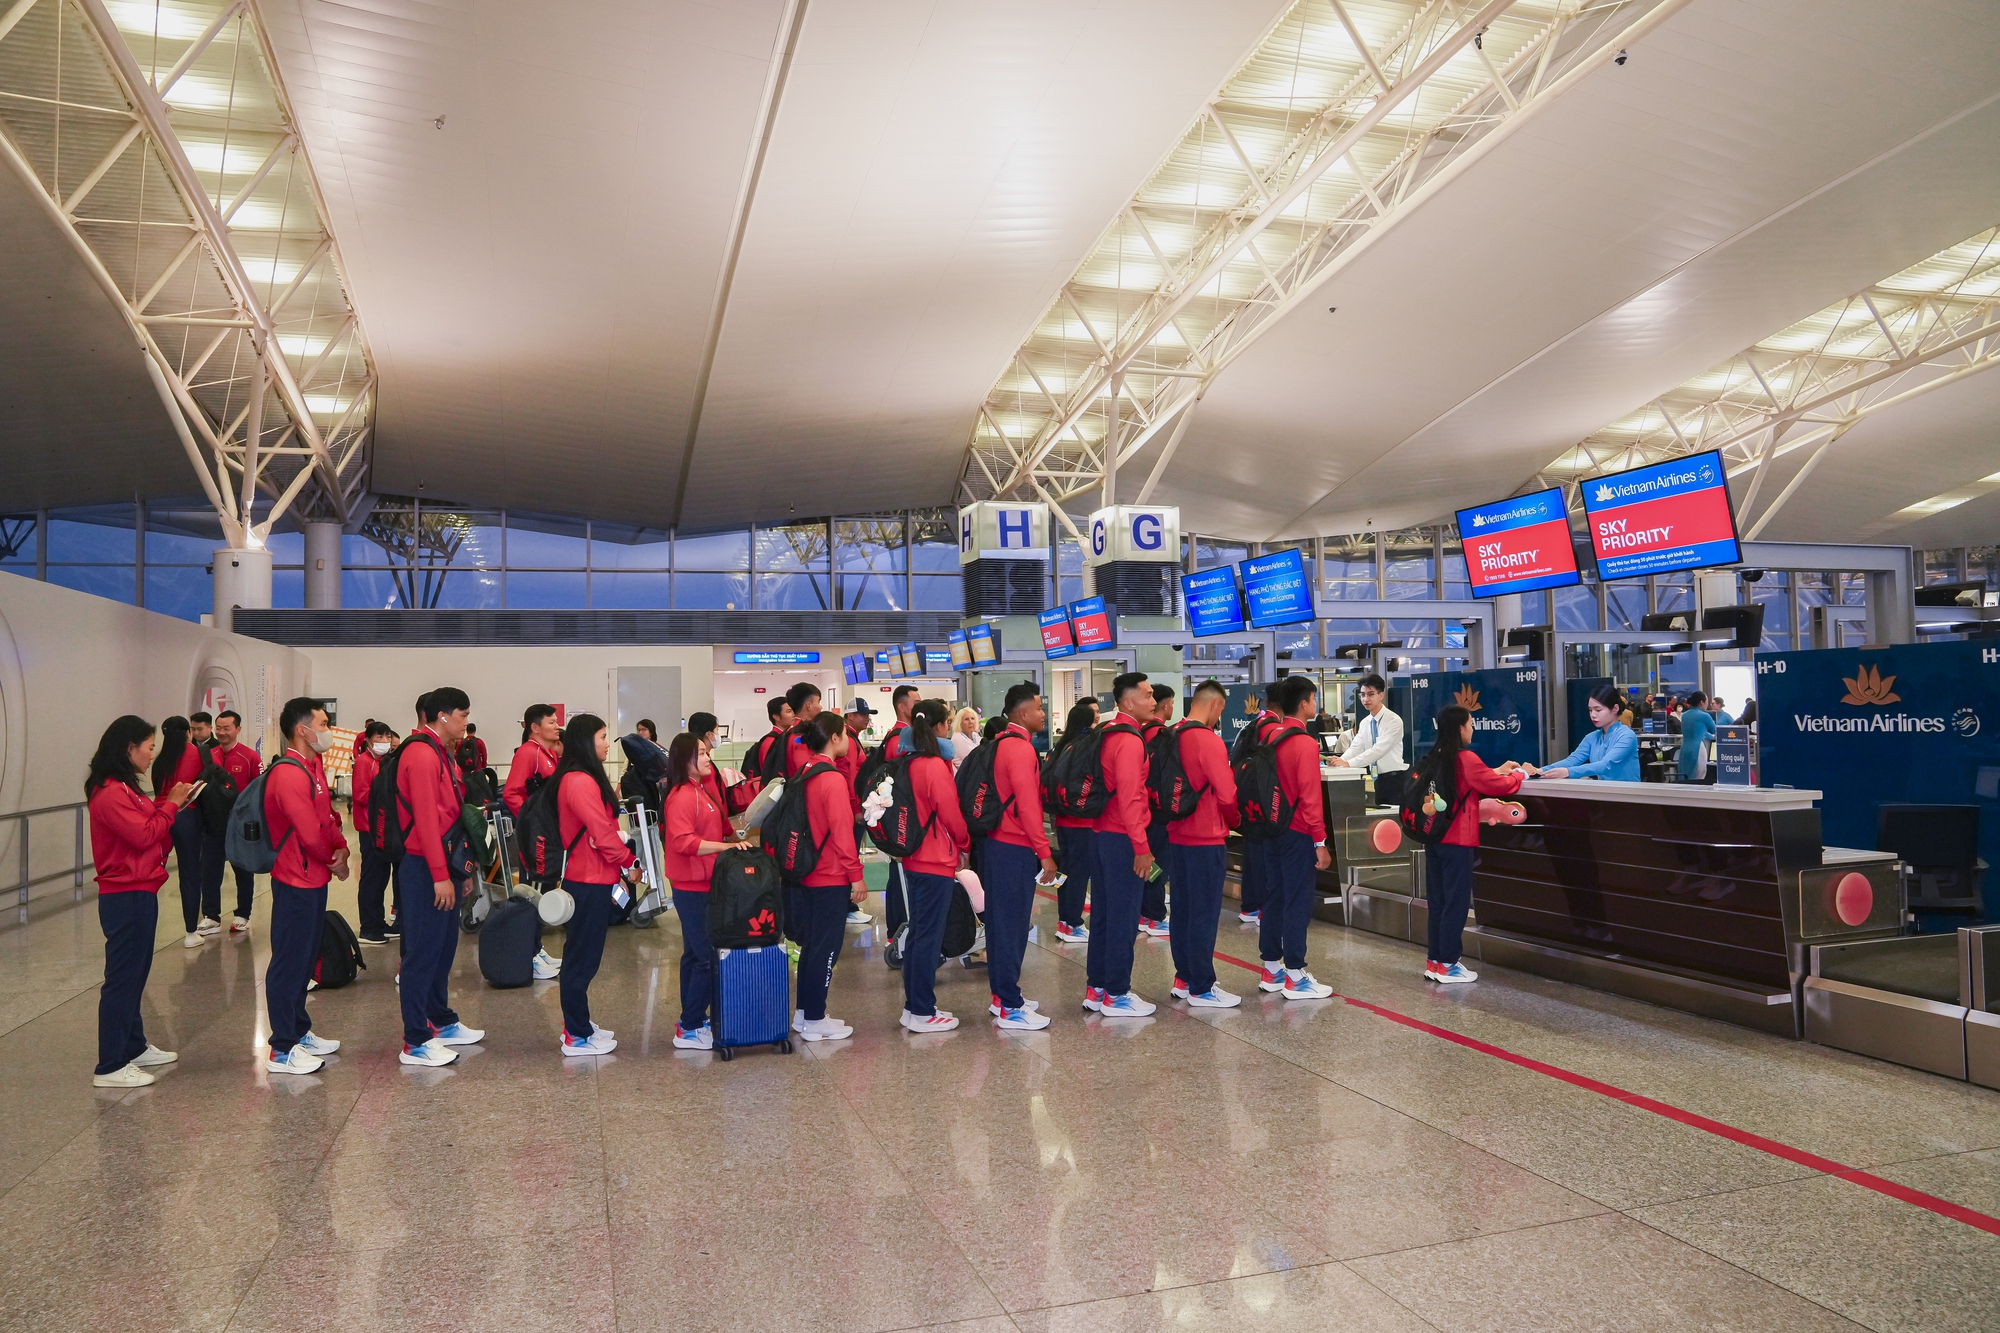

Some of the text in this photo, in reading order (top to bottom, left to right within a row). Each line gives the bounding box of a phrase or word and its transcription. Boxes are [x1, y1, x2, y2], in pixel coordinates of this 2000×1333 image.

[962, 513, 972, 553] H
[999, 510, 1031, 548] H
[1132, 514, 1162, 551] G
[1598, 519, 1627, 536] SKY
[1092, 520, 1104, 556] G
[1601, 526, 1670, 551] PRIORITY
[1478, 542, 1502, 558] SKY
[1480, 550, 1537, 571] PRIORITY
[1516, 671, 1537, 682] H-09
[1757, 660, 1787, 674] H-10
[1794, 713, 1946, 733] Vietnam Airlines
[1725, 765, 1741, 773] Closed
